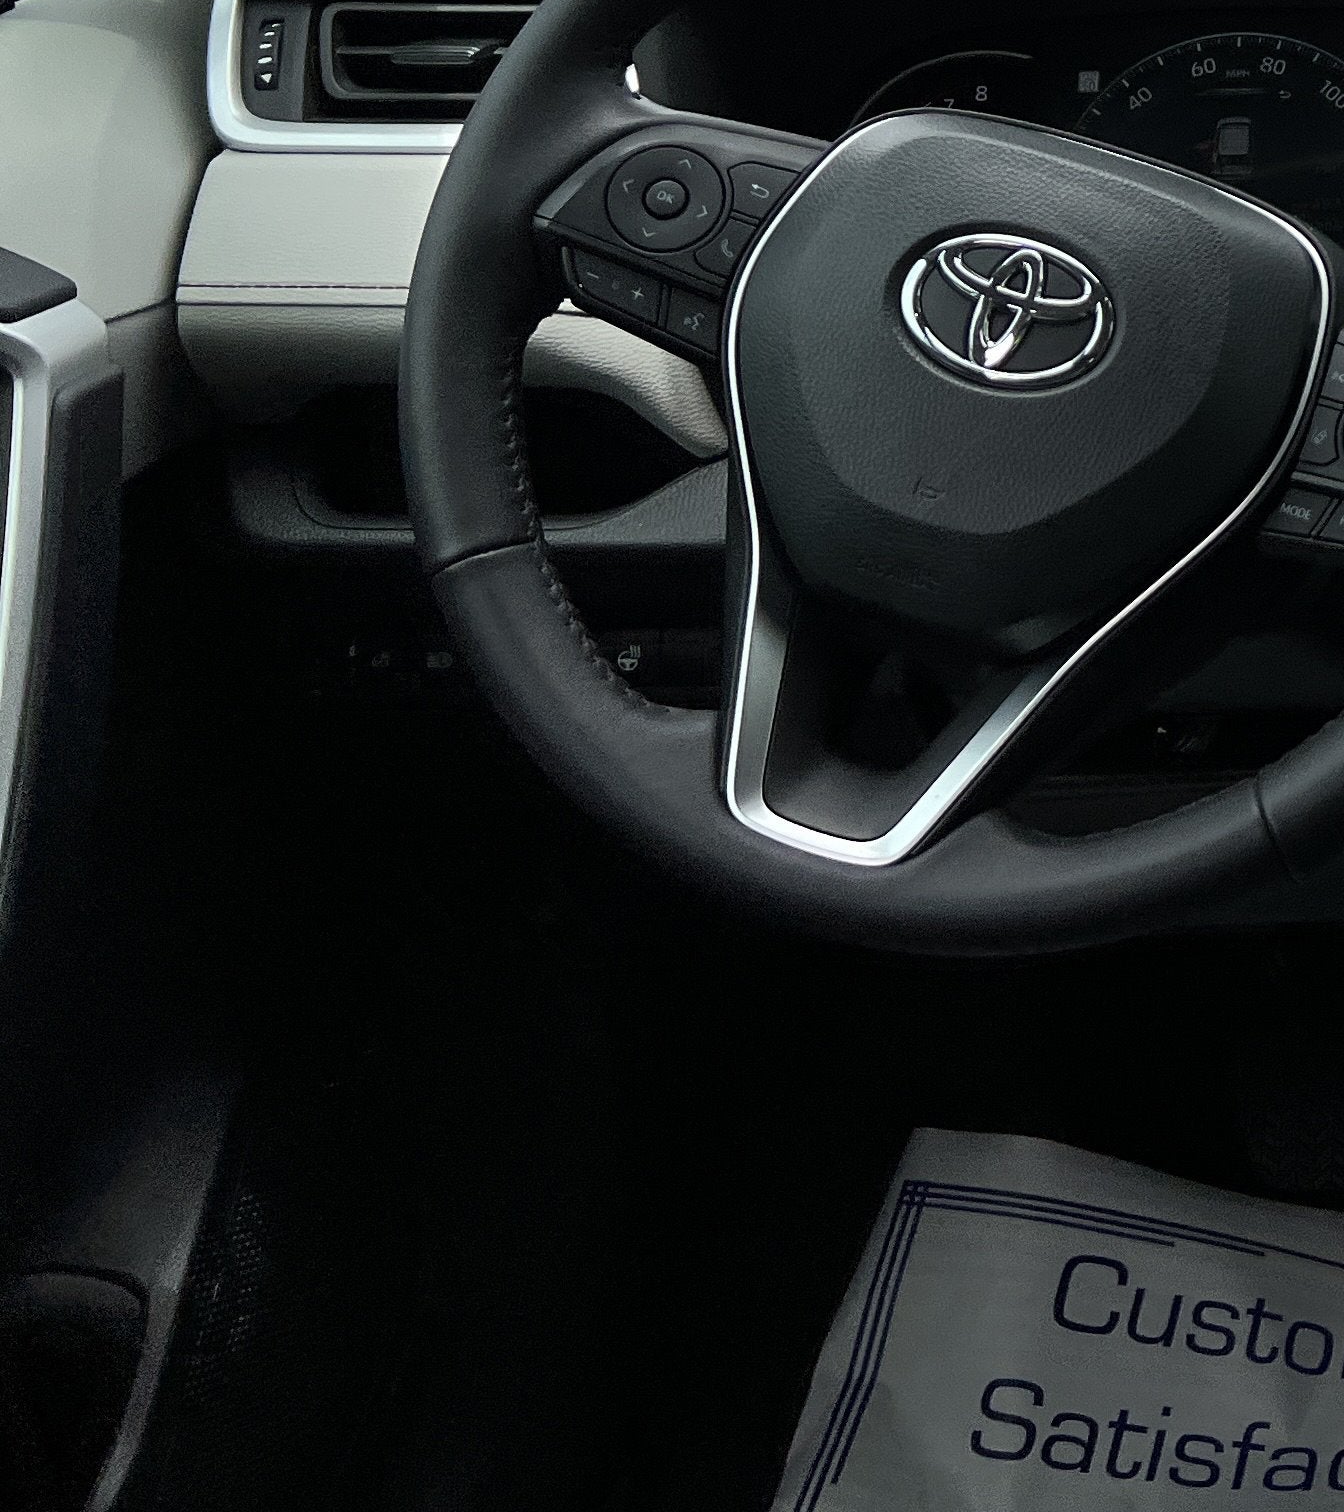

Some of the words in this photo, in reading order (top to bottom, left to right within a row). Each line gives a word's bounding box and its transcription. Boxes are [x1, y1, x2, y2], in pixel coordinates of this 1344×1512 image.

[1190, 56, 1217, 78] 60
[1258, 55, 1287, 78] 80
[975, 85, 988, 102] 8
[1126, 87, 1154, 112] 40
[656, 189, 674, 205] OK
[1279, 502, 1312, 521] MODE
